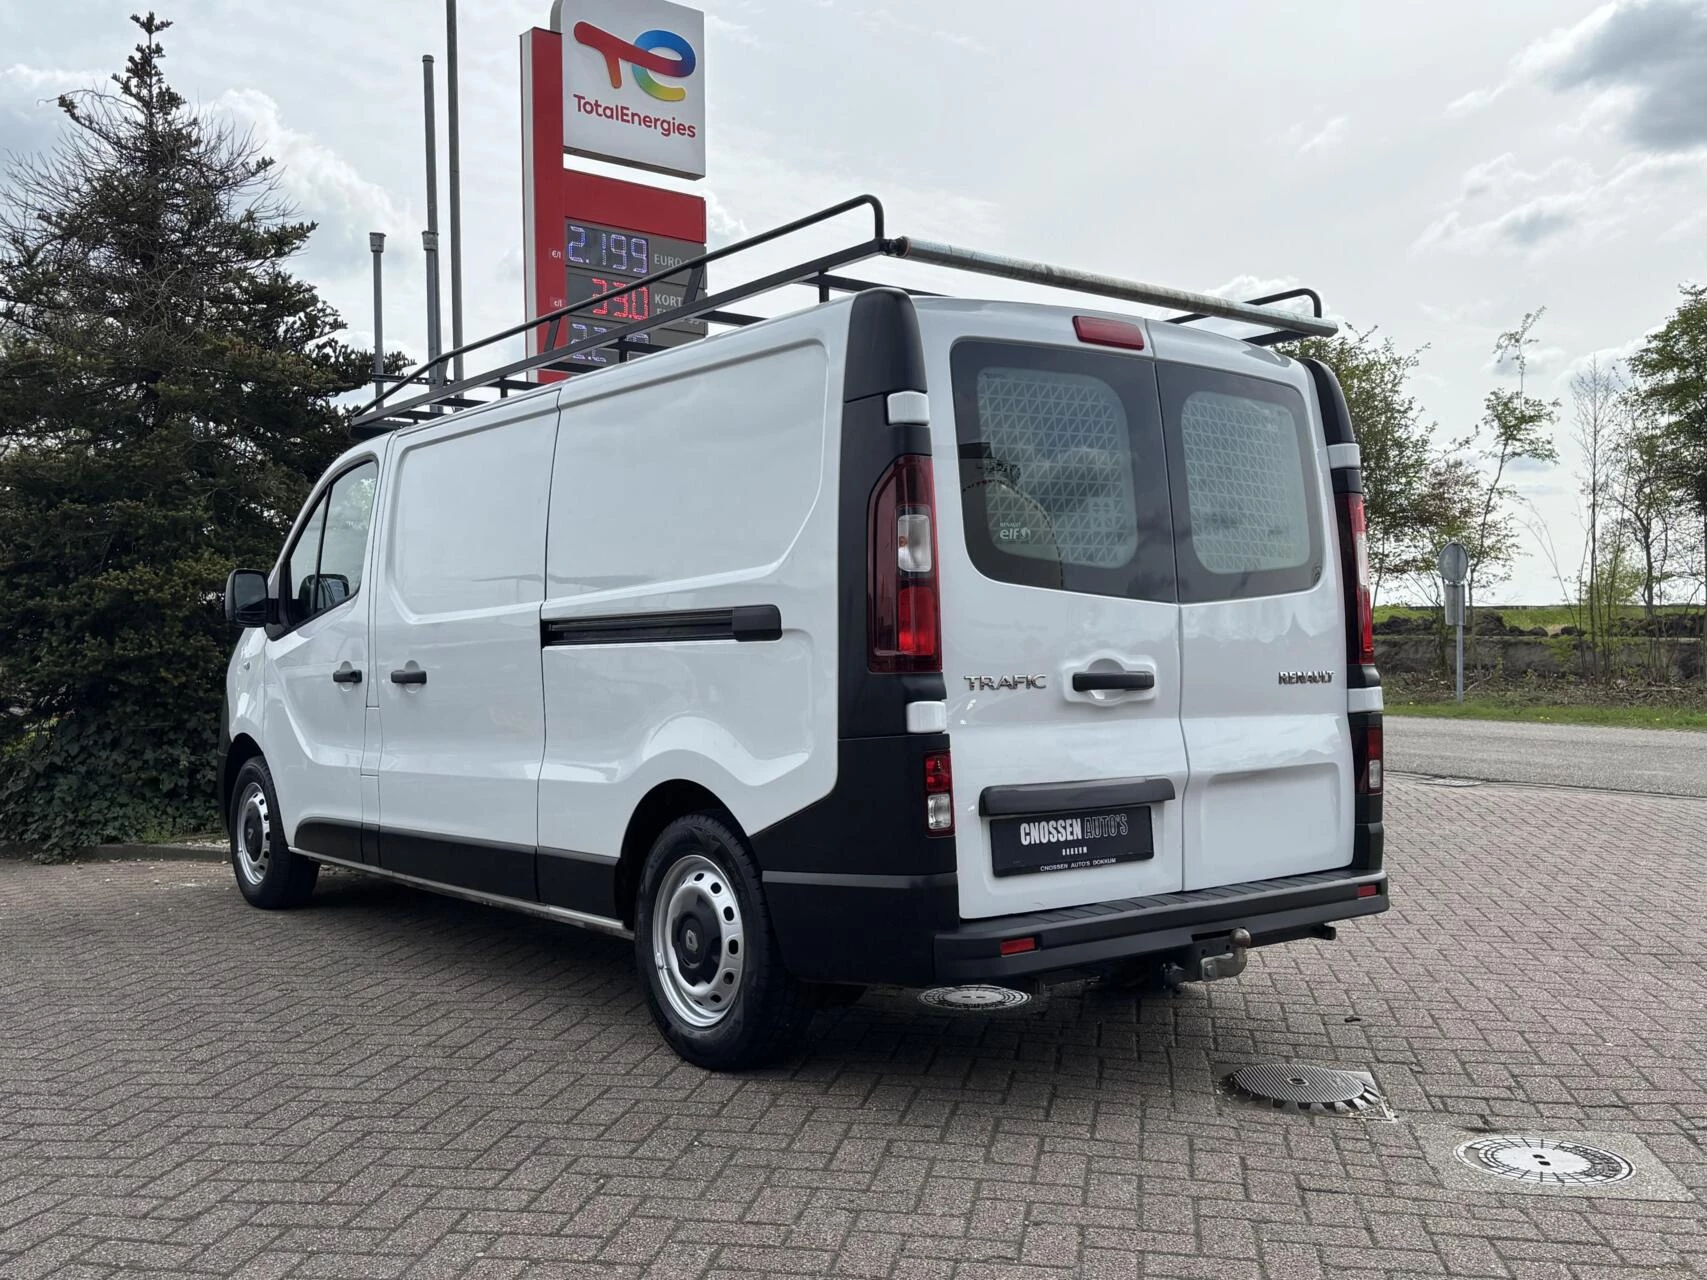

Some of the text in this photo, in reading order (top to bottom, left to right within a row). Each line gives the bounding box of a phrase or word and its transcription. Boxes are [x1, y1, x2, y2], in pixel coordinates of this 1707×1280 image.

[573, 94, 696, 138] TotalEnergies
[999, 528, 1020, 539] elf
[964, 674, 1047, 691] TRAFIC
[1278, 670, 1336, 685] RENAULT
[1020, 814, 1129, 846] CNOSSEN AUTO'S
[1040, 857, 1117, 872] CNOSSEN AUTO'S DOKKUM
